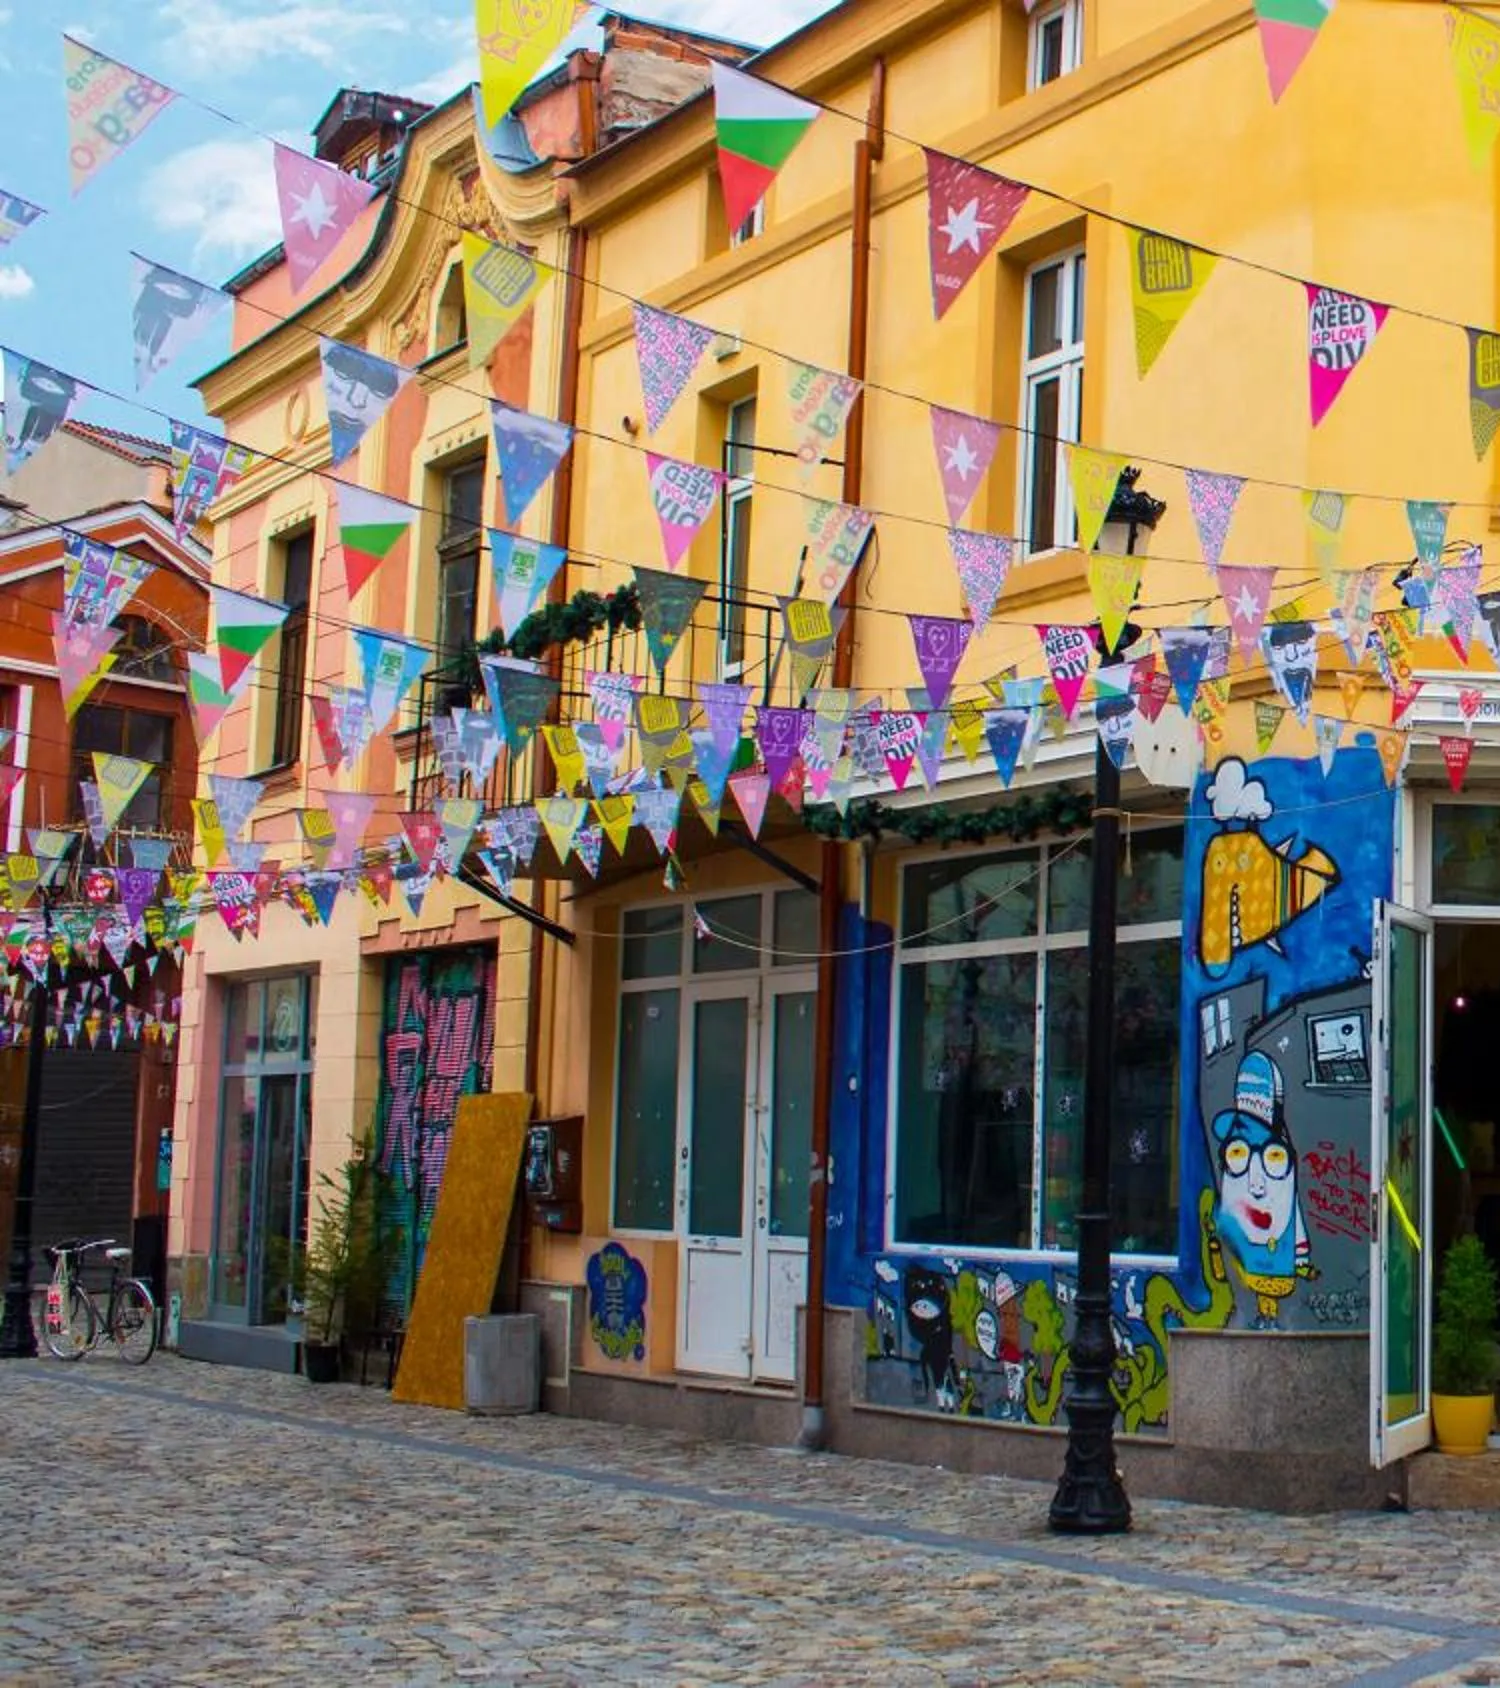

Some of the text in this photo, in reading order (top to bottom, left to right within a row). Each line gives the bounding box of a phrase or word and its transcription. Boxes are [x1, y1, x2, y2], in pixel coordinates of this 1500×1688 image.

[1313, 303, 1366, 331] NEED
[1311, 340, 1366, 370] DIV
[1046, 633, 1083, 656] NEED
[880, 718, 913, 741] NEED
[1303, 1148, 1371, 1184] BACK
